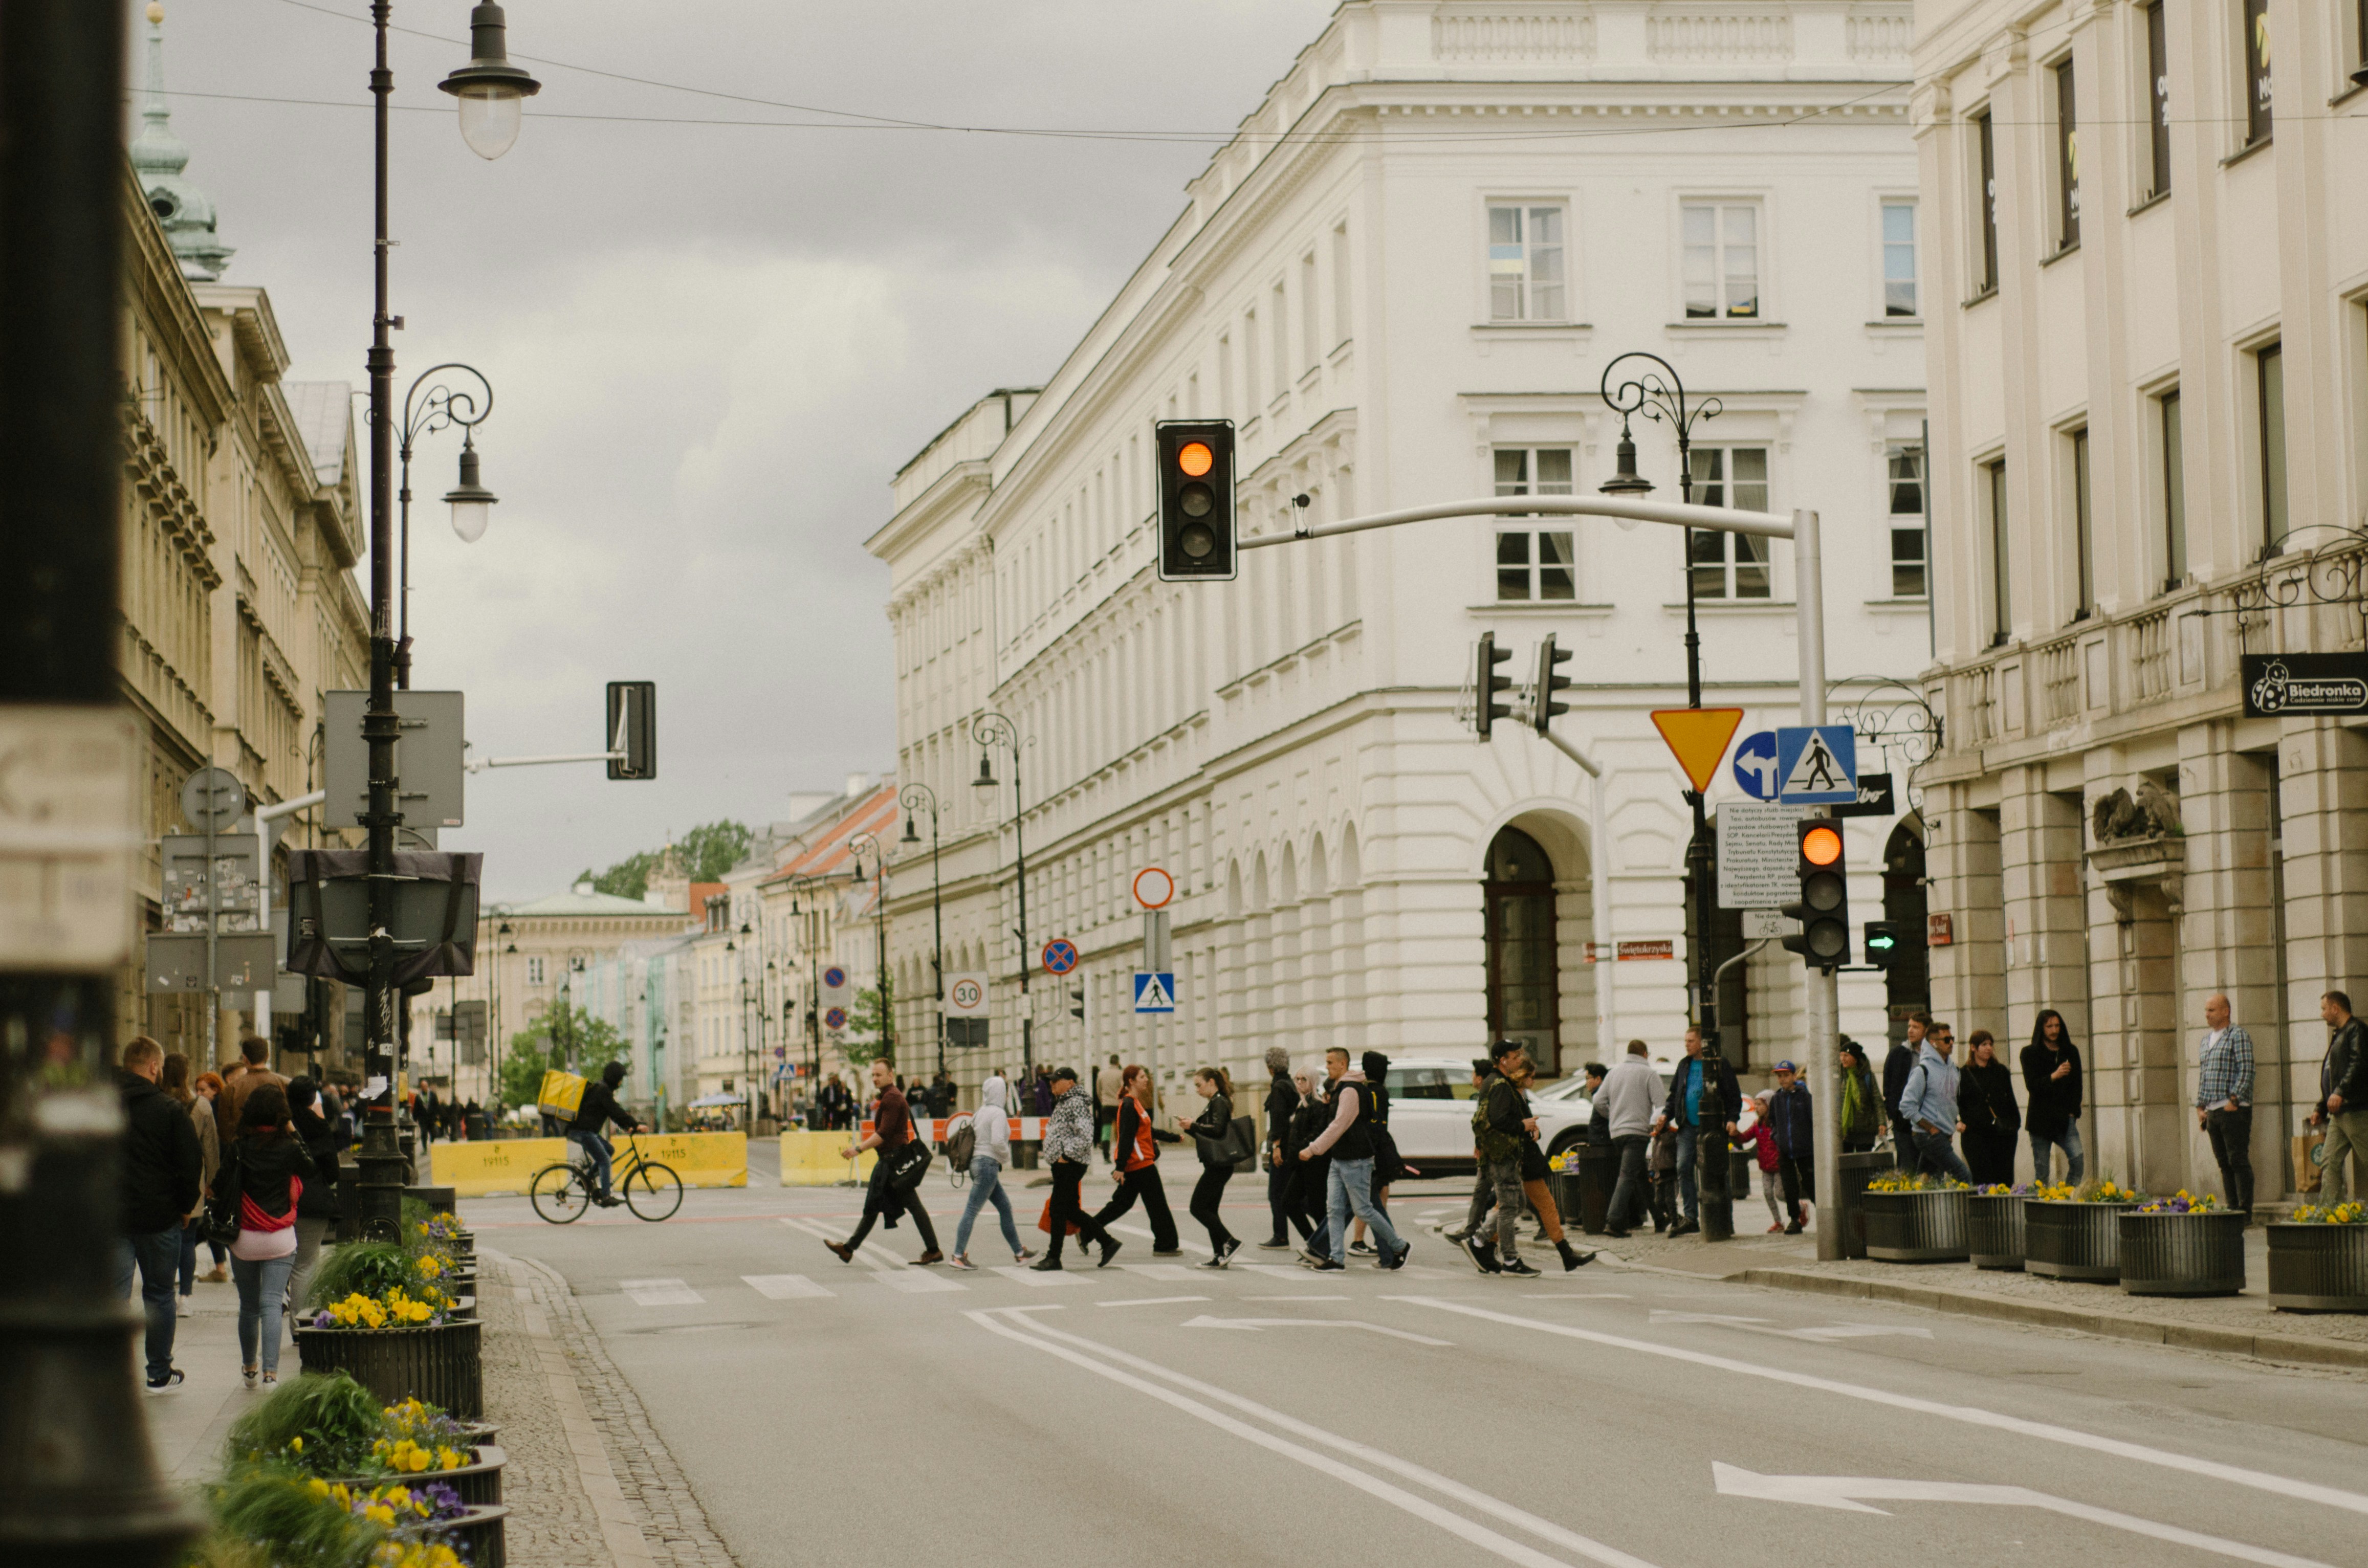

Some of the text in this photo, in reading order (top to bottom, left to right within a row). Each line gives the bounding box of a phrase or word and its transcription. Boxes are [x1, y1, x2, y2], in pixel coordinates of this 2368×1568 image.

[2289, 683, 2361, 697] Biedronka
[1618, 944, 1672, 957] Świętokrzyska
[957, 987, 978, 1002] 30
[661, 1148, 686, 1160] 19115
[483, 1155, 510, 1167] 19115
